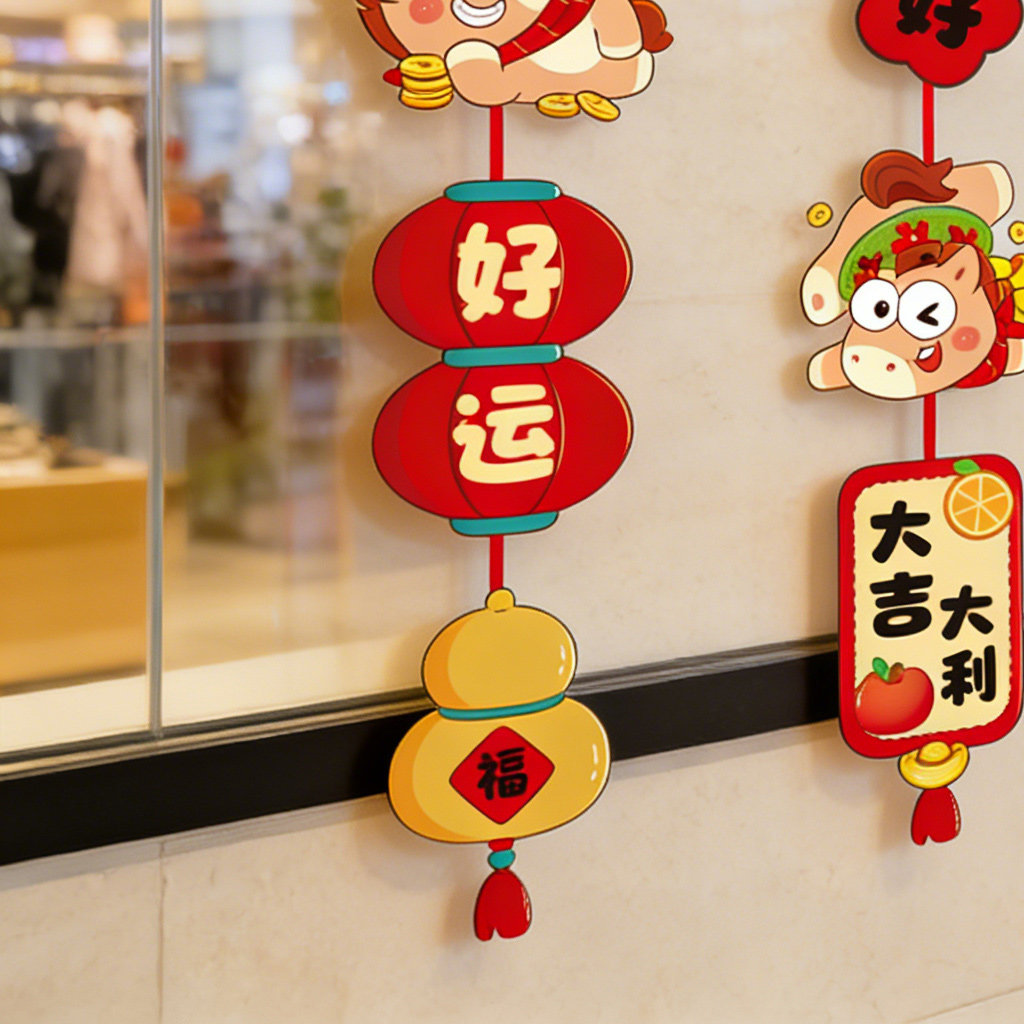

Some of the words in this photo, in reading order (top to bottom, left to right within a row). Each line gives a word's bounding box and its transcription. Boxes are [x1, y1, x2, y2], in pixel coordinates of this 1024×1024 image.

[452, 222, 561, 484] 好运
[869, 500, 933, 638] 大吉
[940, 585, 997, 706] 大利
[477, 746, 529, 801] 福
